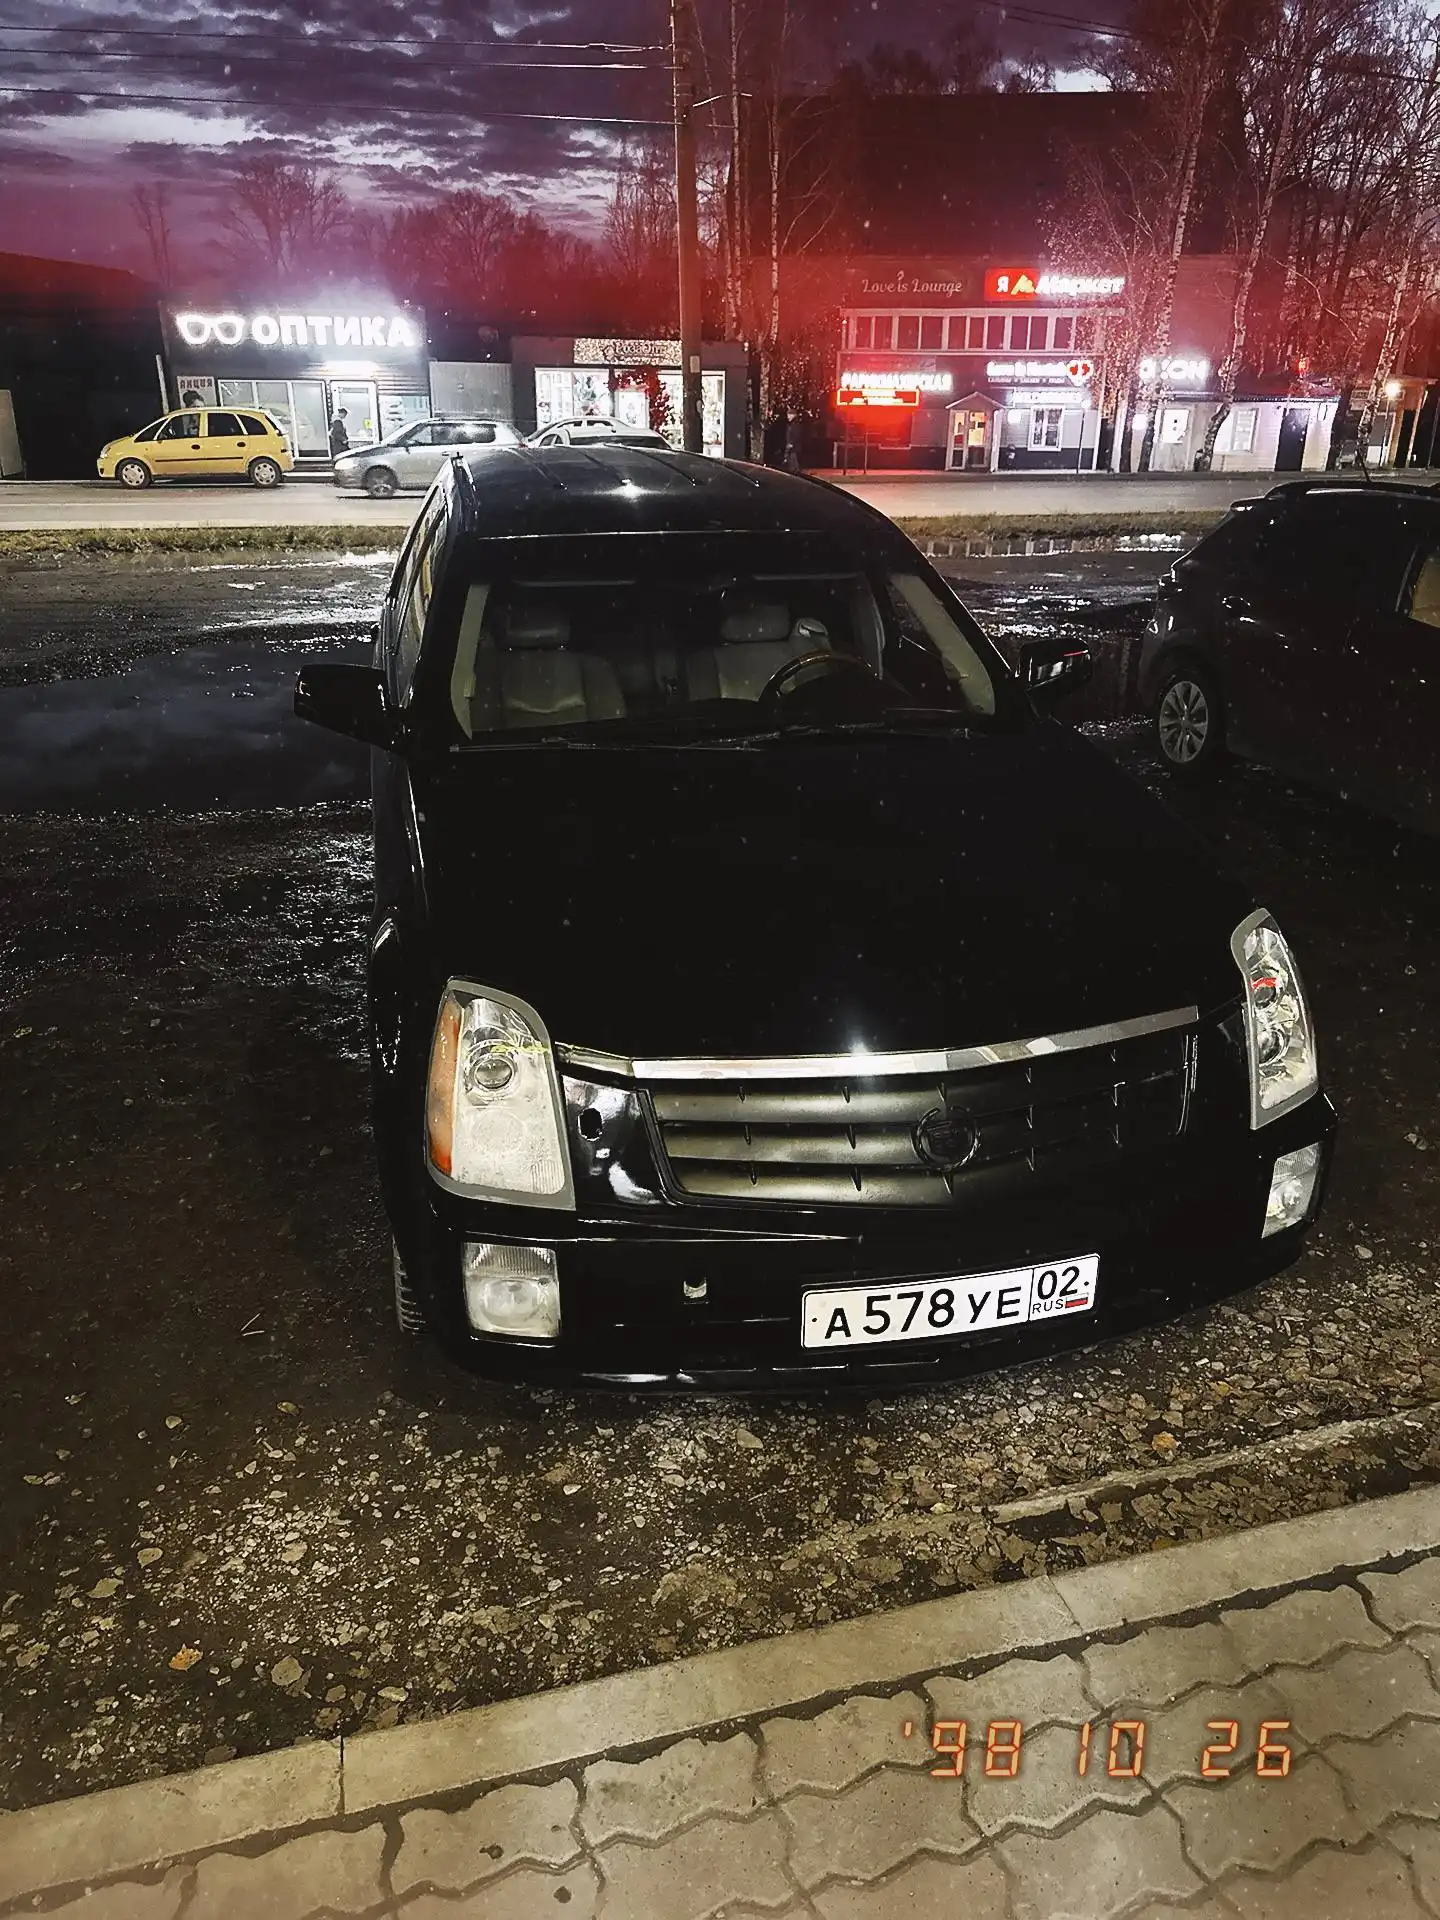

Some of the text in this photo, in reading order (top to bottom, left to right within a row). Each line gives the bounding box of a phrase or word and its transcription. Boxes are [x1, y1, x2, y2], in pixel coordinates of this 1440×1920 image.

[862, 279, 895, 293] Love
[912, 279, 962, 298] Lounge
[251, 315, 416, 347] ОПТИКА
[180, 378, 213, 390] АКЦИЯ
[1036, 1265, 1081, 1301] 02
[1031, 1299, 1064, 1315] RUS
